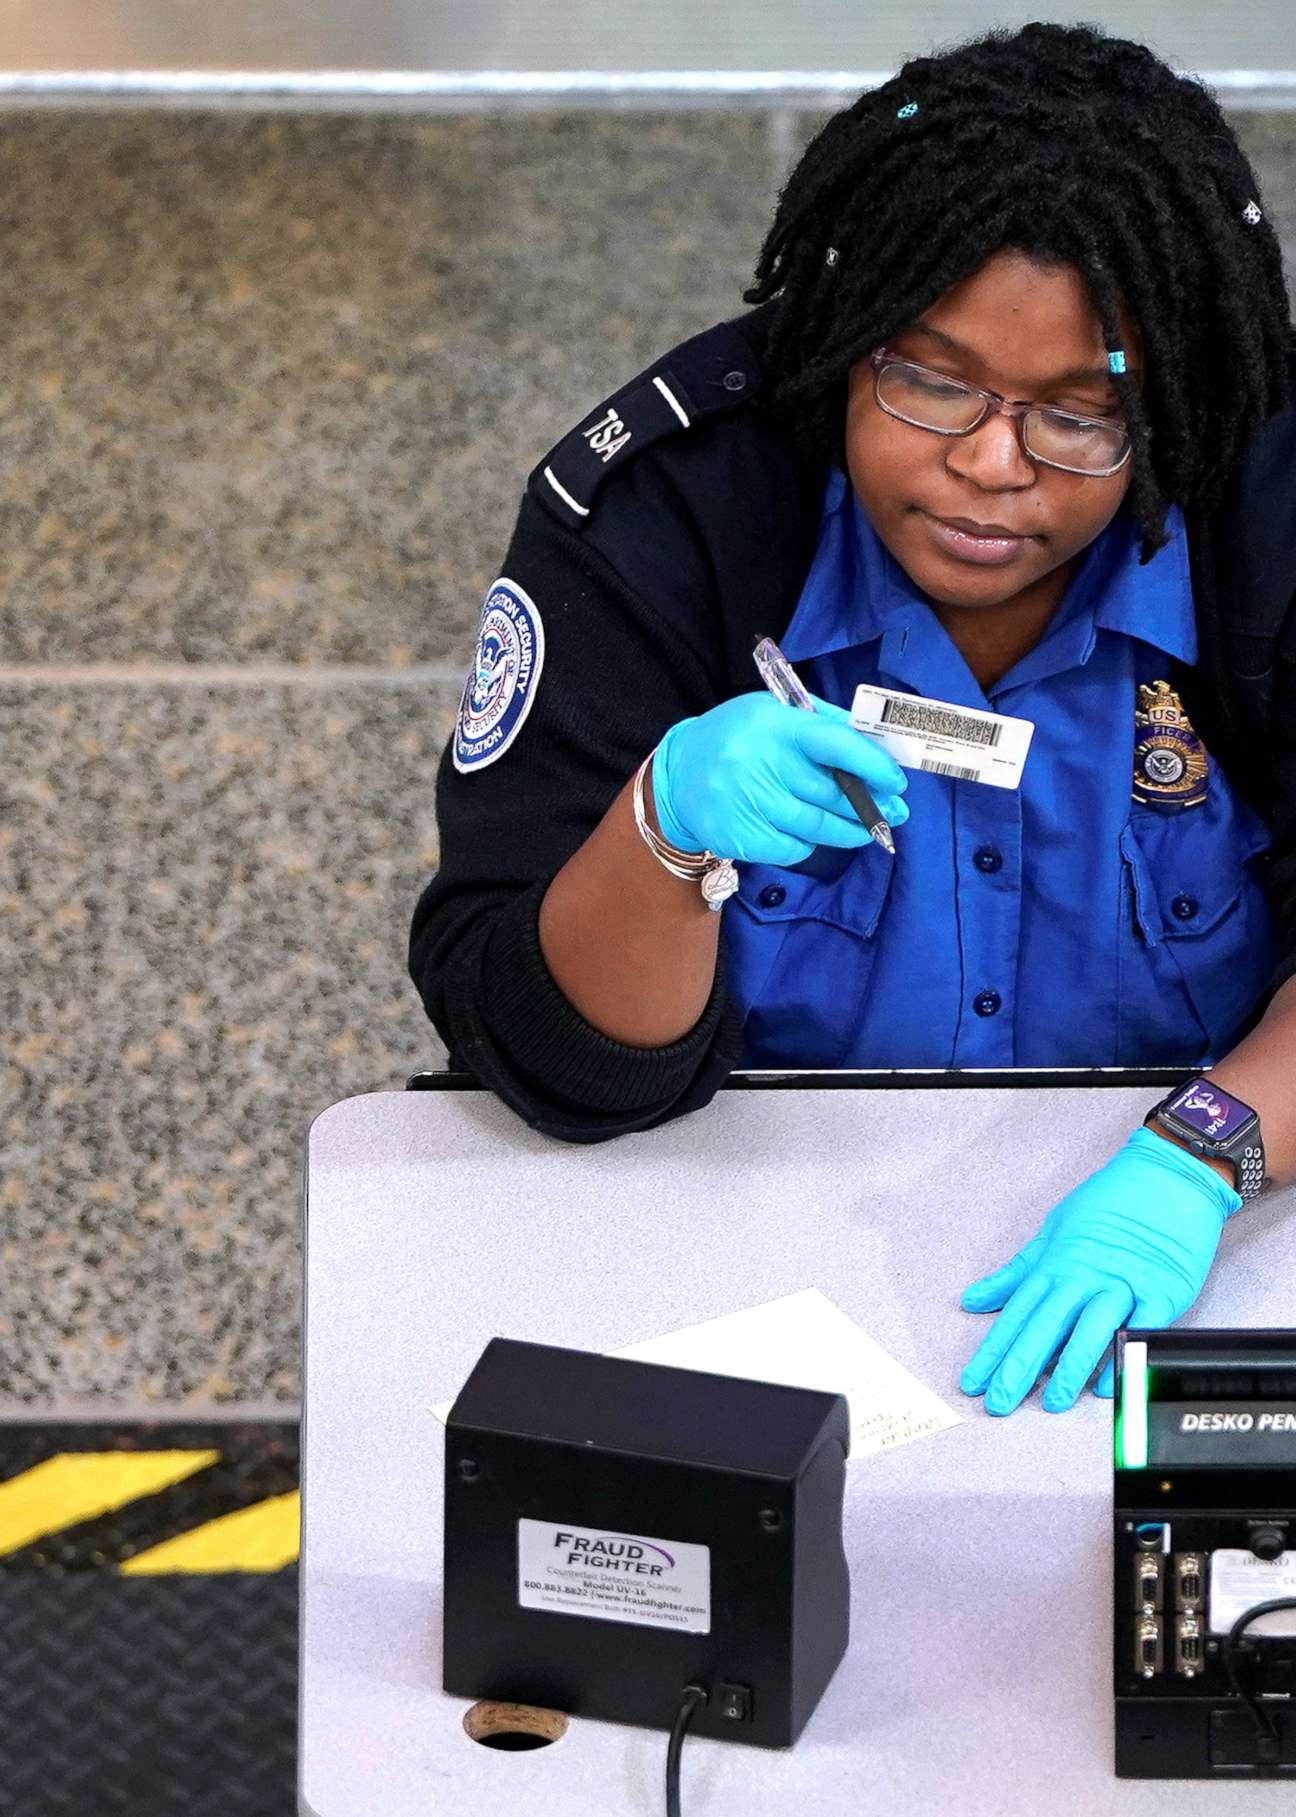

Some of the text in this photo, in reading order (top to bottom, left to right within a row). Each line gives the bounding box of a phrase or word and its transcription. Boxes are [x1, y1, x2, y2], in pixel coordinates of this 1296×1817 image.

[582, 408, 632, 463] TSA
[515, 614, 537, 695] SECURITY
[1152, 709, 1176, 722] US
[1182, 1412, 1254, 1431] DESKO
[555, 1531, 645, 1560] FRAUD
[567, 1551, 664, 1577] FIGHTER
[583, 1580, 647, 1597] Model UV-16
